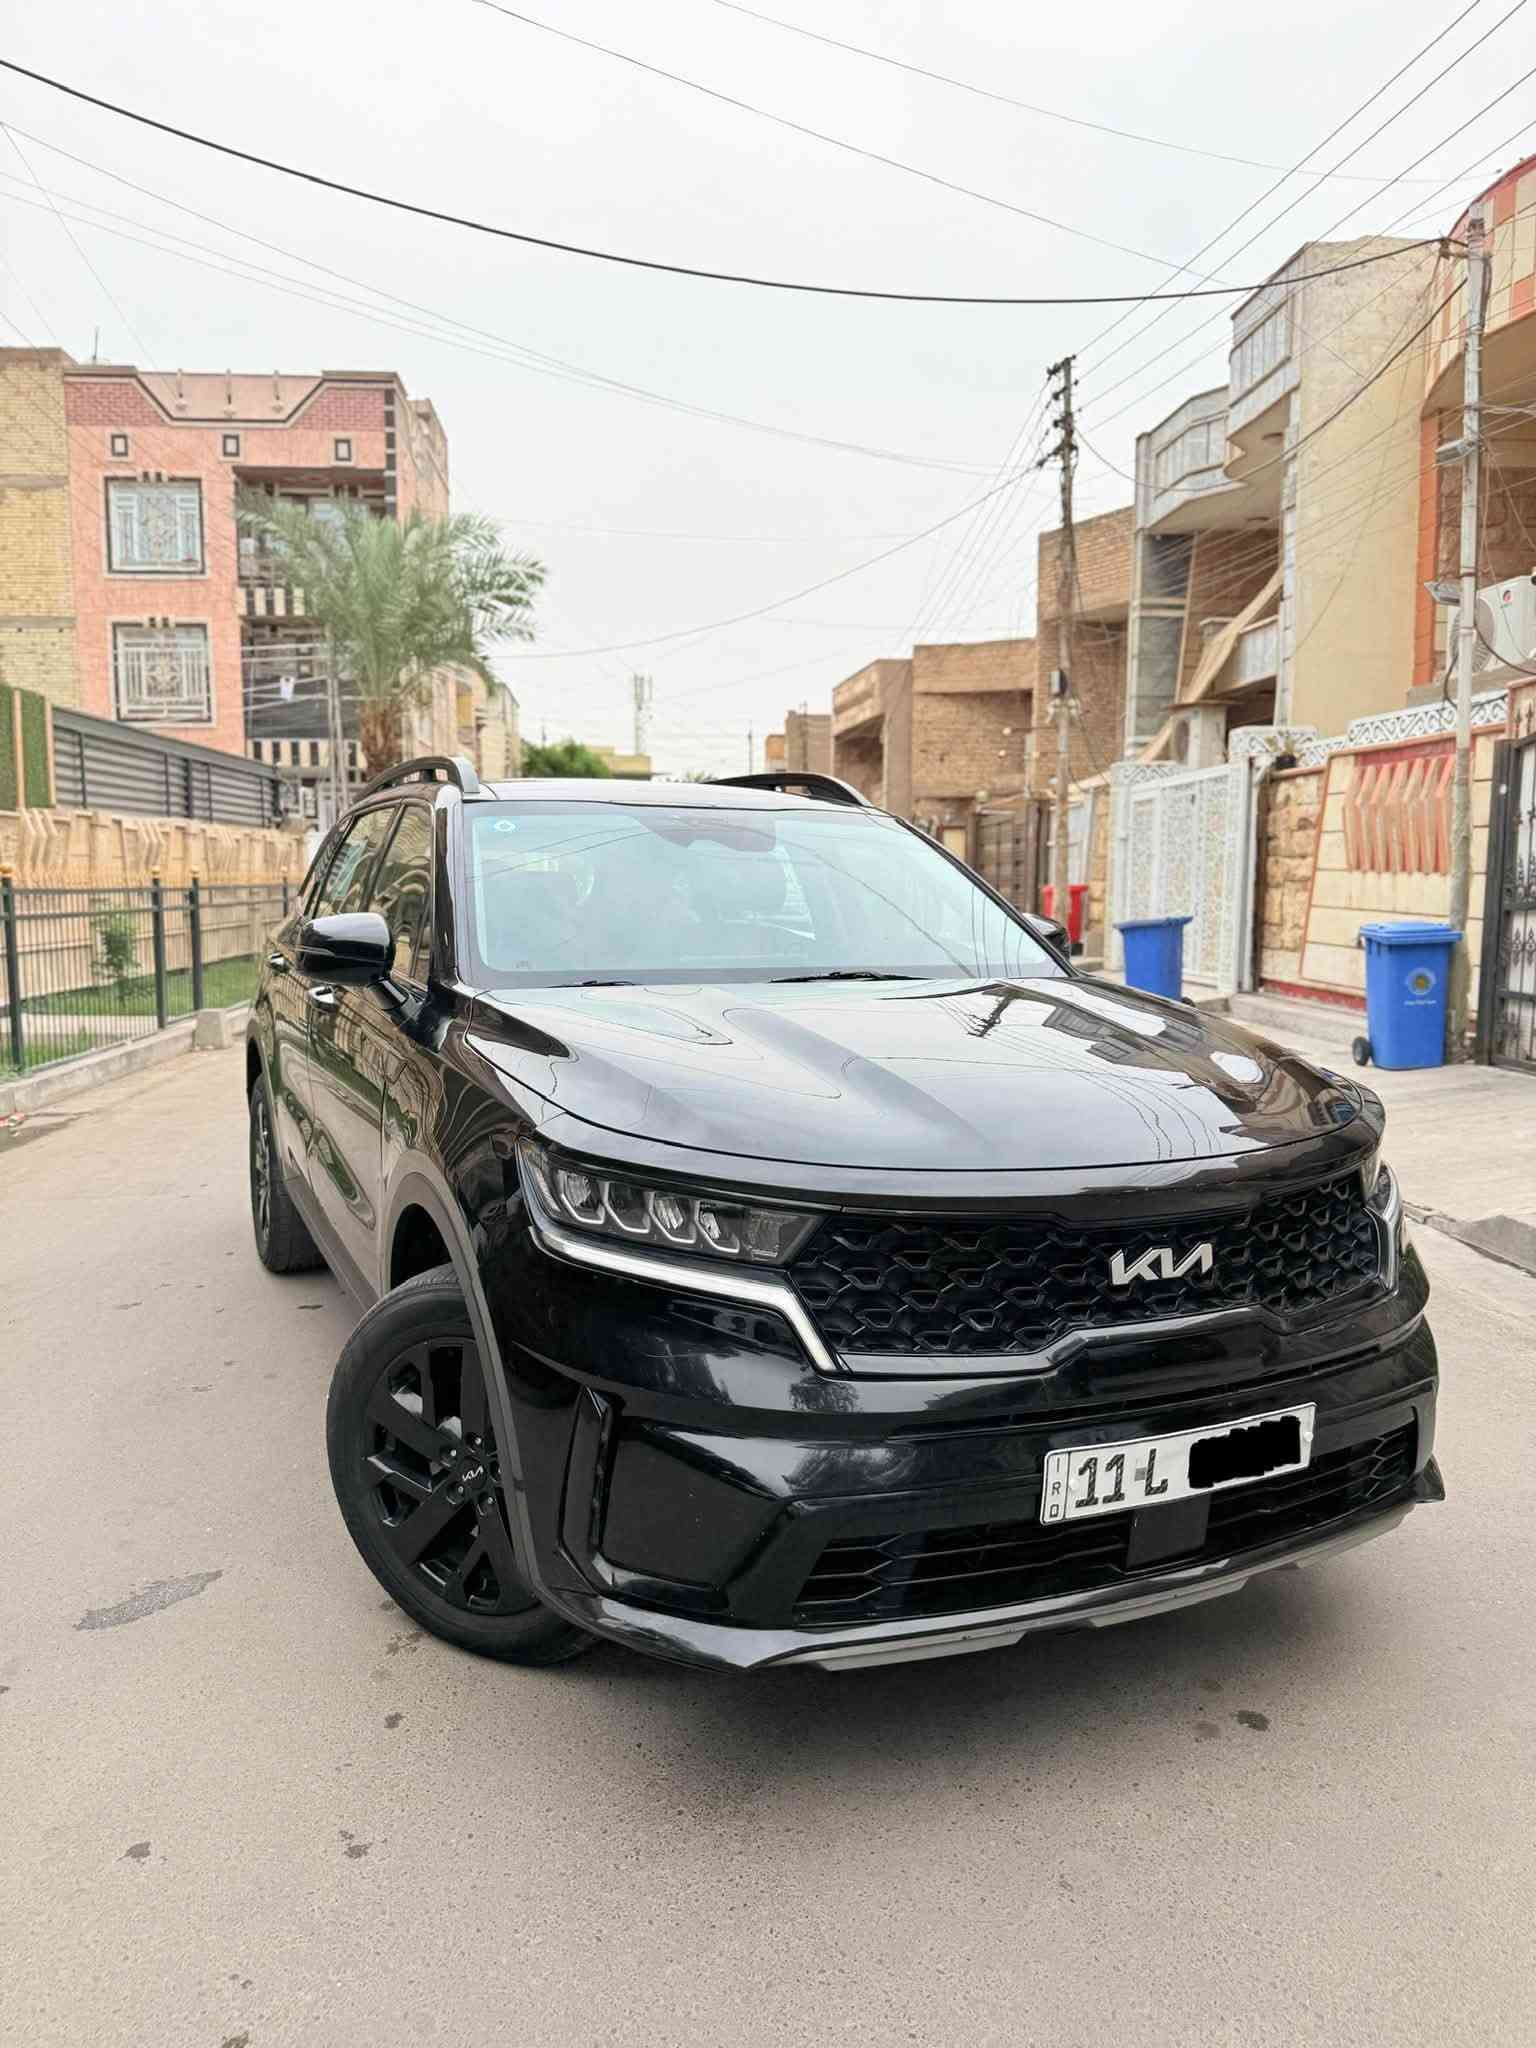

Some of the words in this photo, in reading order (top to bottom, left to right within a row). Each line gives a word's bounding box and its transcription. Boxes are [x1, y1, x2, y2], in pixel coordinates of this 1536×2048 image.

[1110, 1242, 1214, 1286] KIA
[1075, 1453, 1126, 1508] 11
[1144, 1448, 1169, 1496] L
